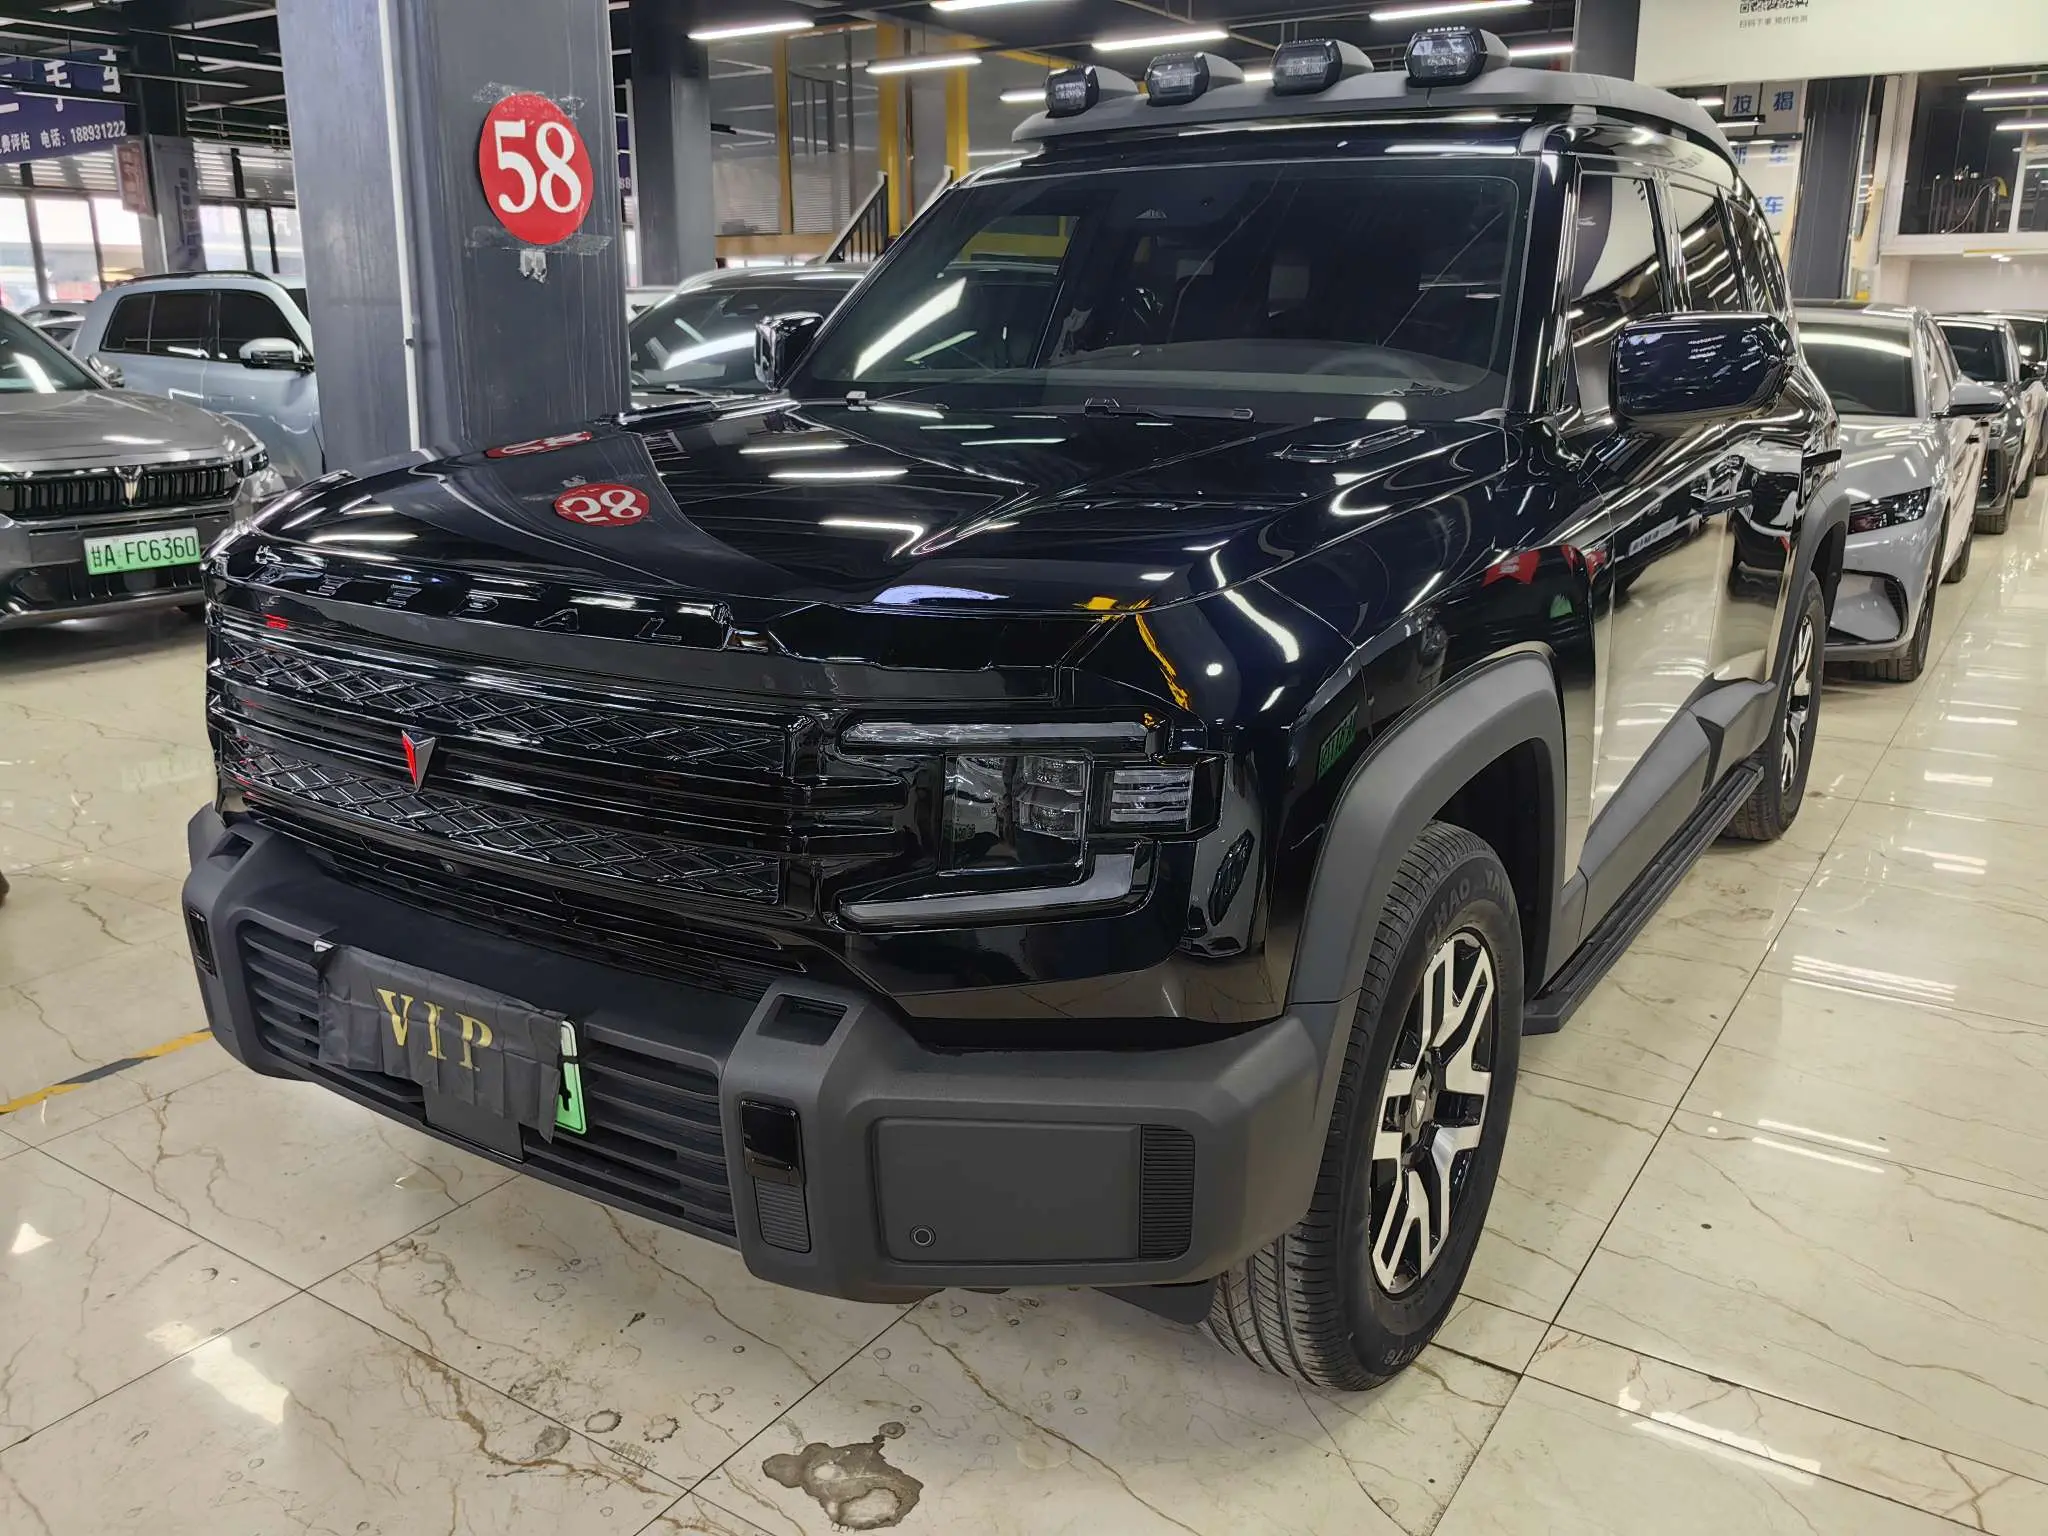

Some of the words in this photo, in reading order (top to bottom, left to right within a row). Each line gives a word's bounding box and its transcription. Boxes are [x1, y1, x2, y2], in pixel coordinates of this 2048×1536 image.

[0, 132, 31, 154] 费评估
[494, 119, 582, 214] 58
[124, 536, 197, 564] FC6360
[377, 988, 494, 1072] VIP
